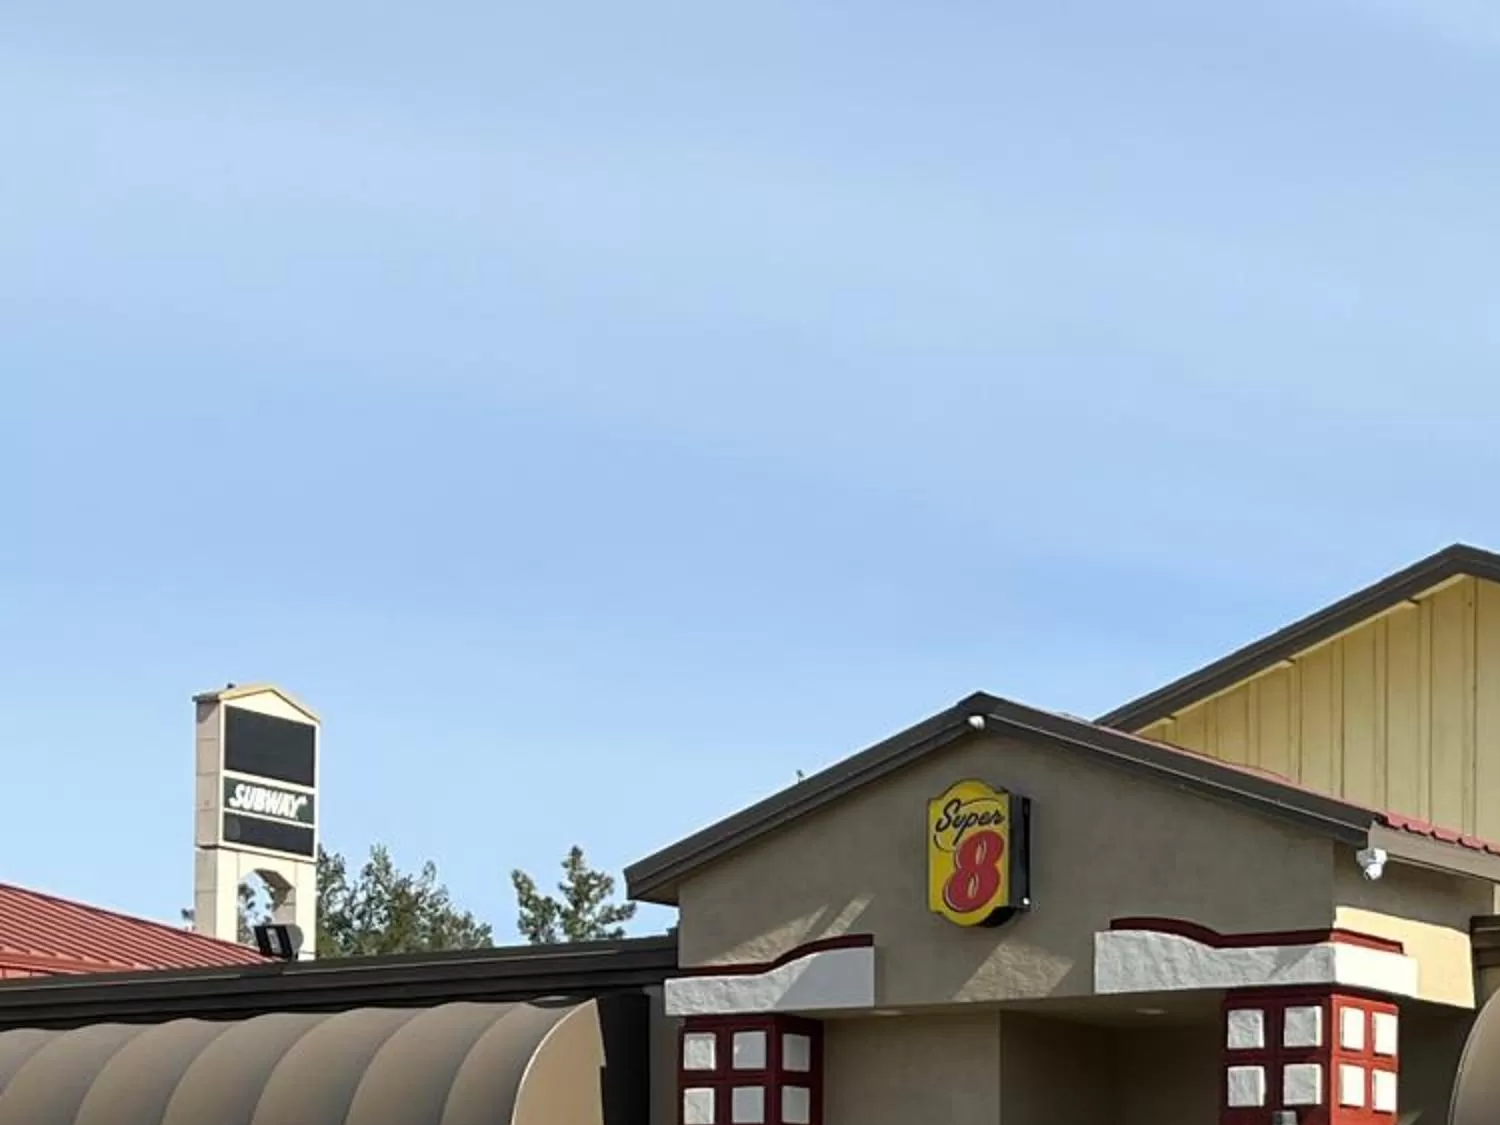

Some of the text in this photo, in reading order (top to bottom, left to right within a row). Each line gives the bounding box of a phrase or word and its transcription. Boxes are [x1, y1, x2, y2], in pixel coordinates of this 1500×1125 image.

[229, 784, 307, 818] SUBWAY
[935, 798, 1005, 847] Super
[942, 829, 1005, 913] 8
